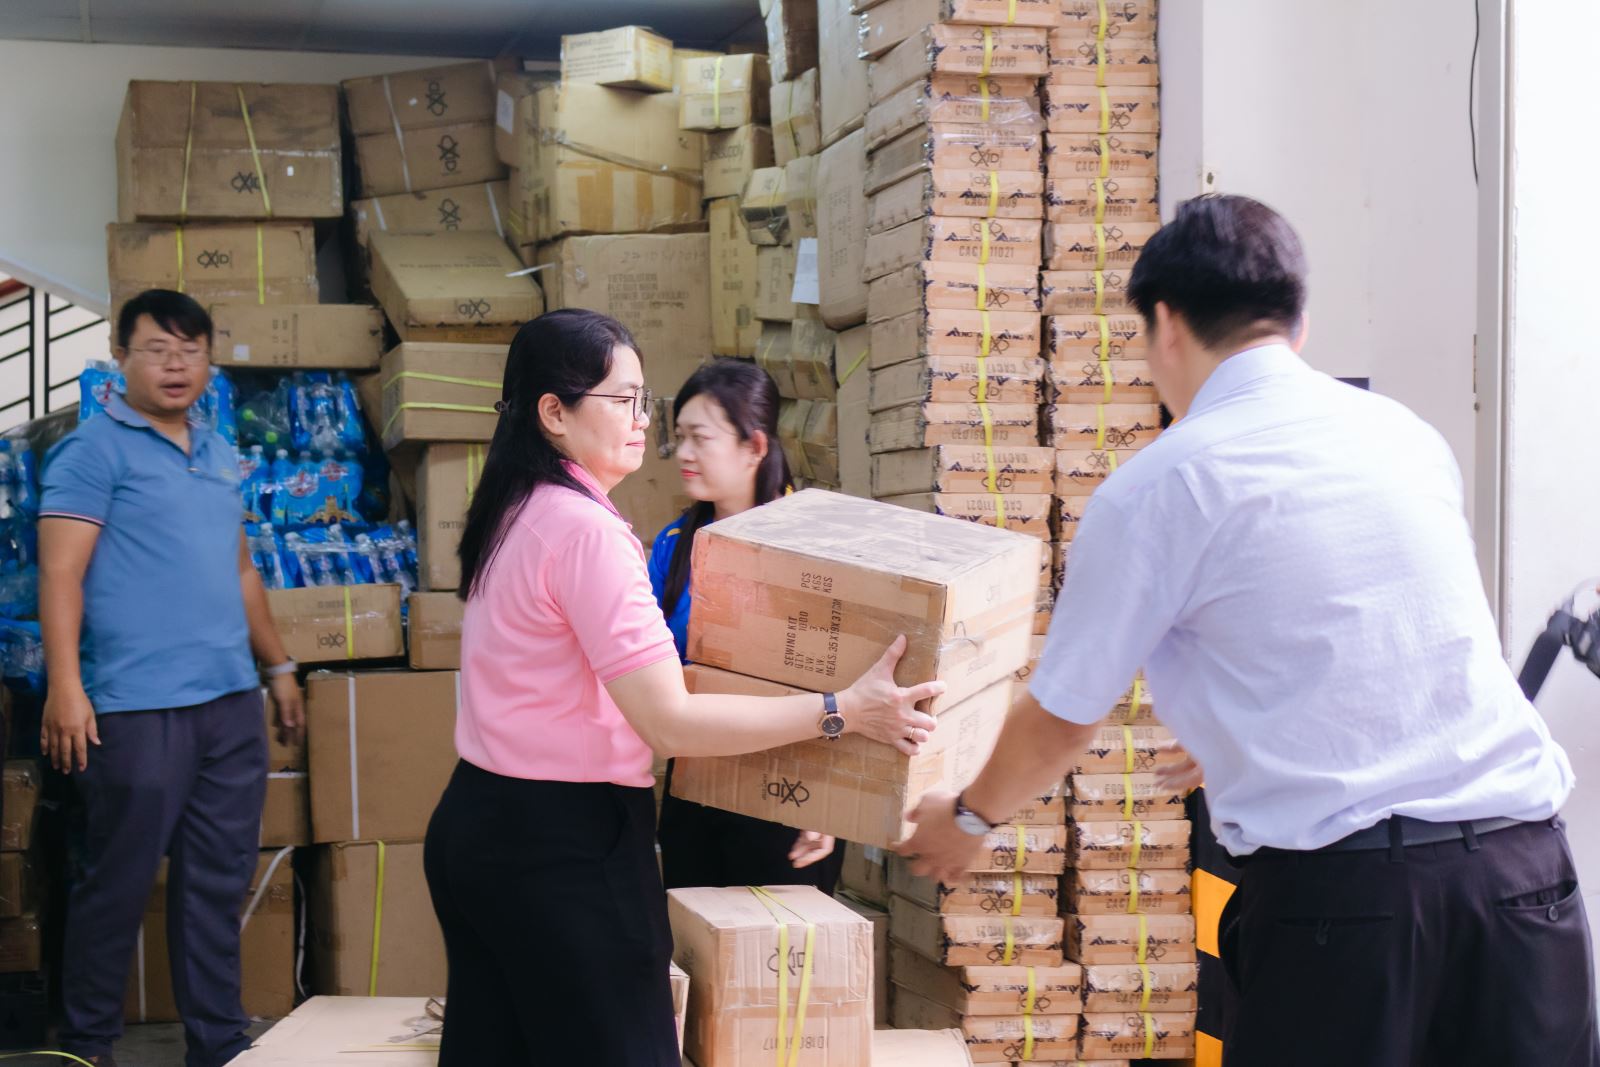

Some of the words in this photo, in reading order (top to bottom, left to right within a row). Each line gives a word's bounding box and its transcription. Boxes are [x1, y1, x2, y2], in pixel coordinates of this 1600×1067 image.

[801, 572, 811, 588] PCS
[812, 574, 822, 591] KGS
[822, 576, 833, 593] KGS
[787, 616, 797, 631] KIT
[798, 611, 809, 631] 1000
[784, 632, 796, 666] SEWING
